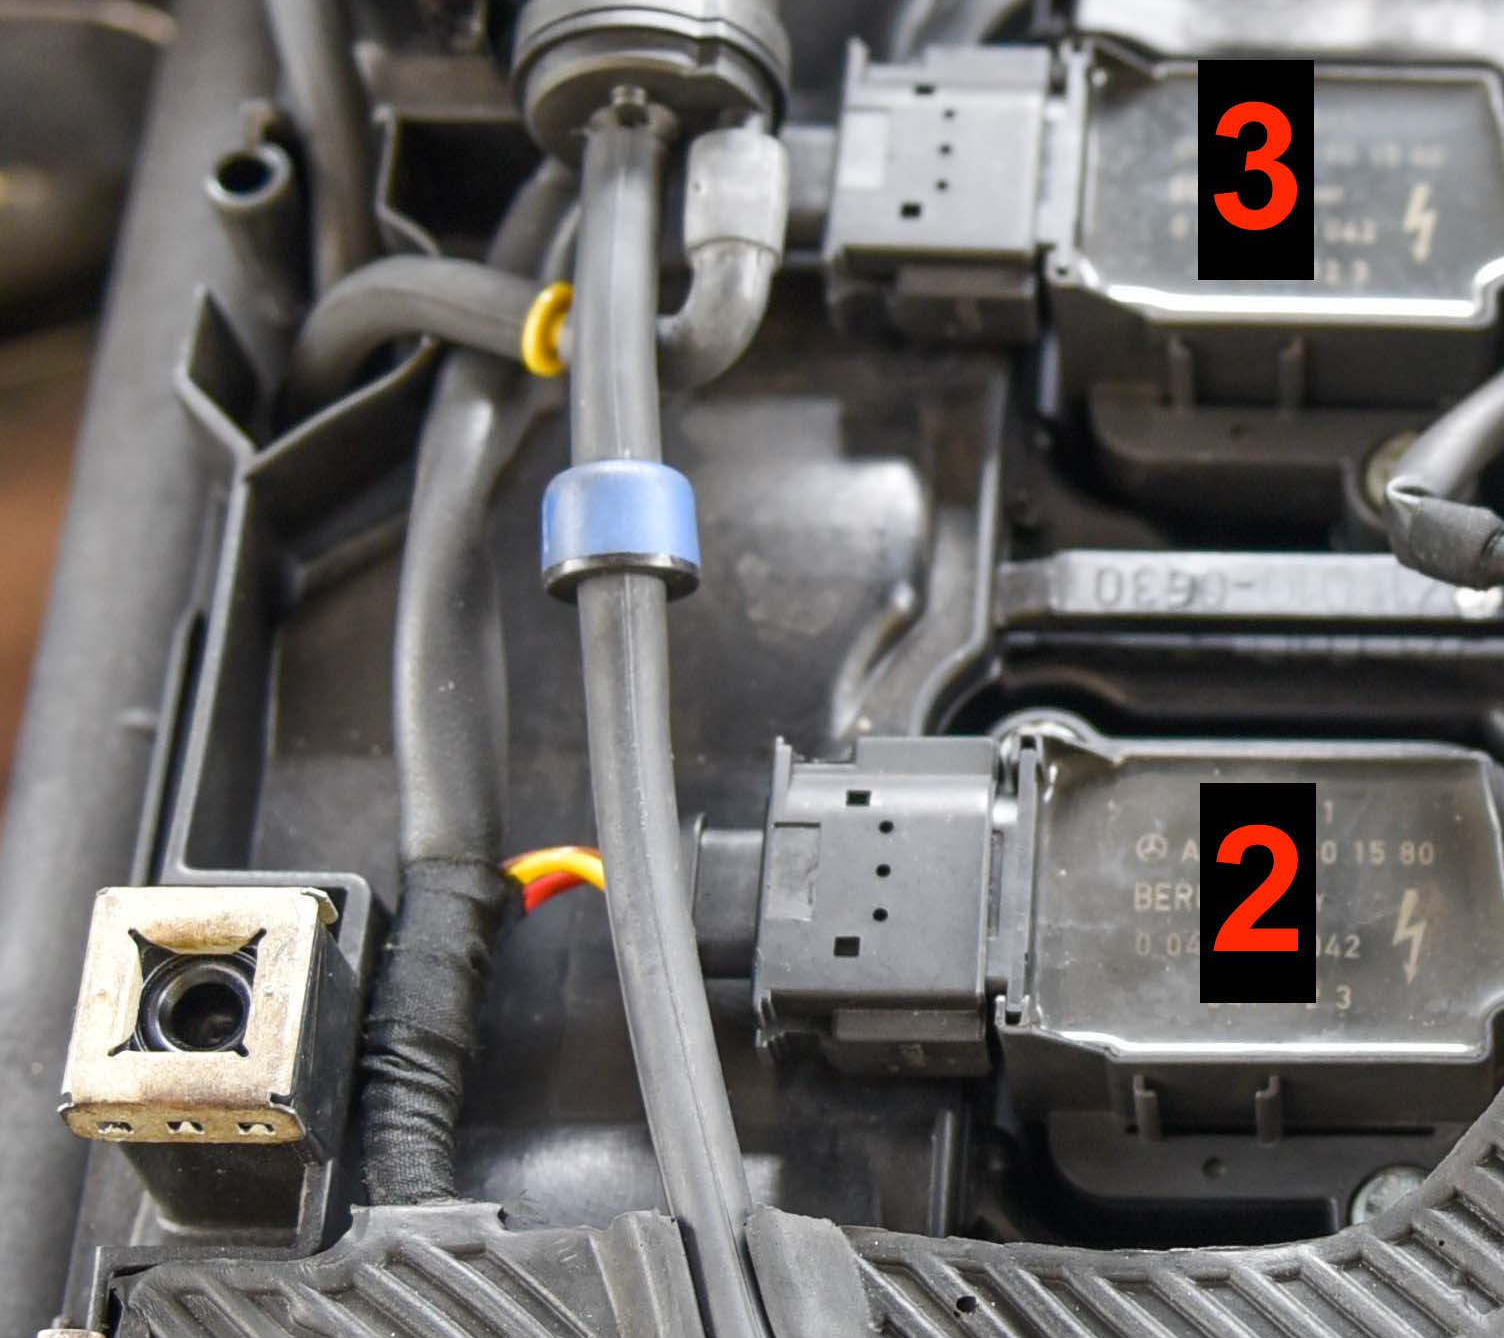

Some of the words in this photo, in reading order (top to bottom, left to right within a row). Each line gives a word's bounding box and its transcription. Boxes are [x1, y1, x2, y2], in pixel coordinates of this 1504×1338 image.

[1354, 840, 1386, 865] 15
[1399, 841, 1435, 866] 80
[1133, 882, 1200, 912] BER
[1316, 934, 1361, 959] 42
